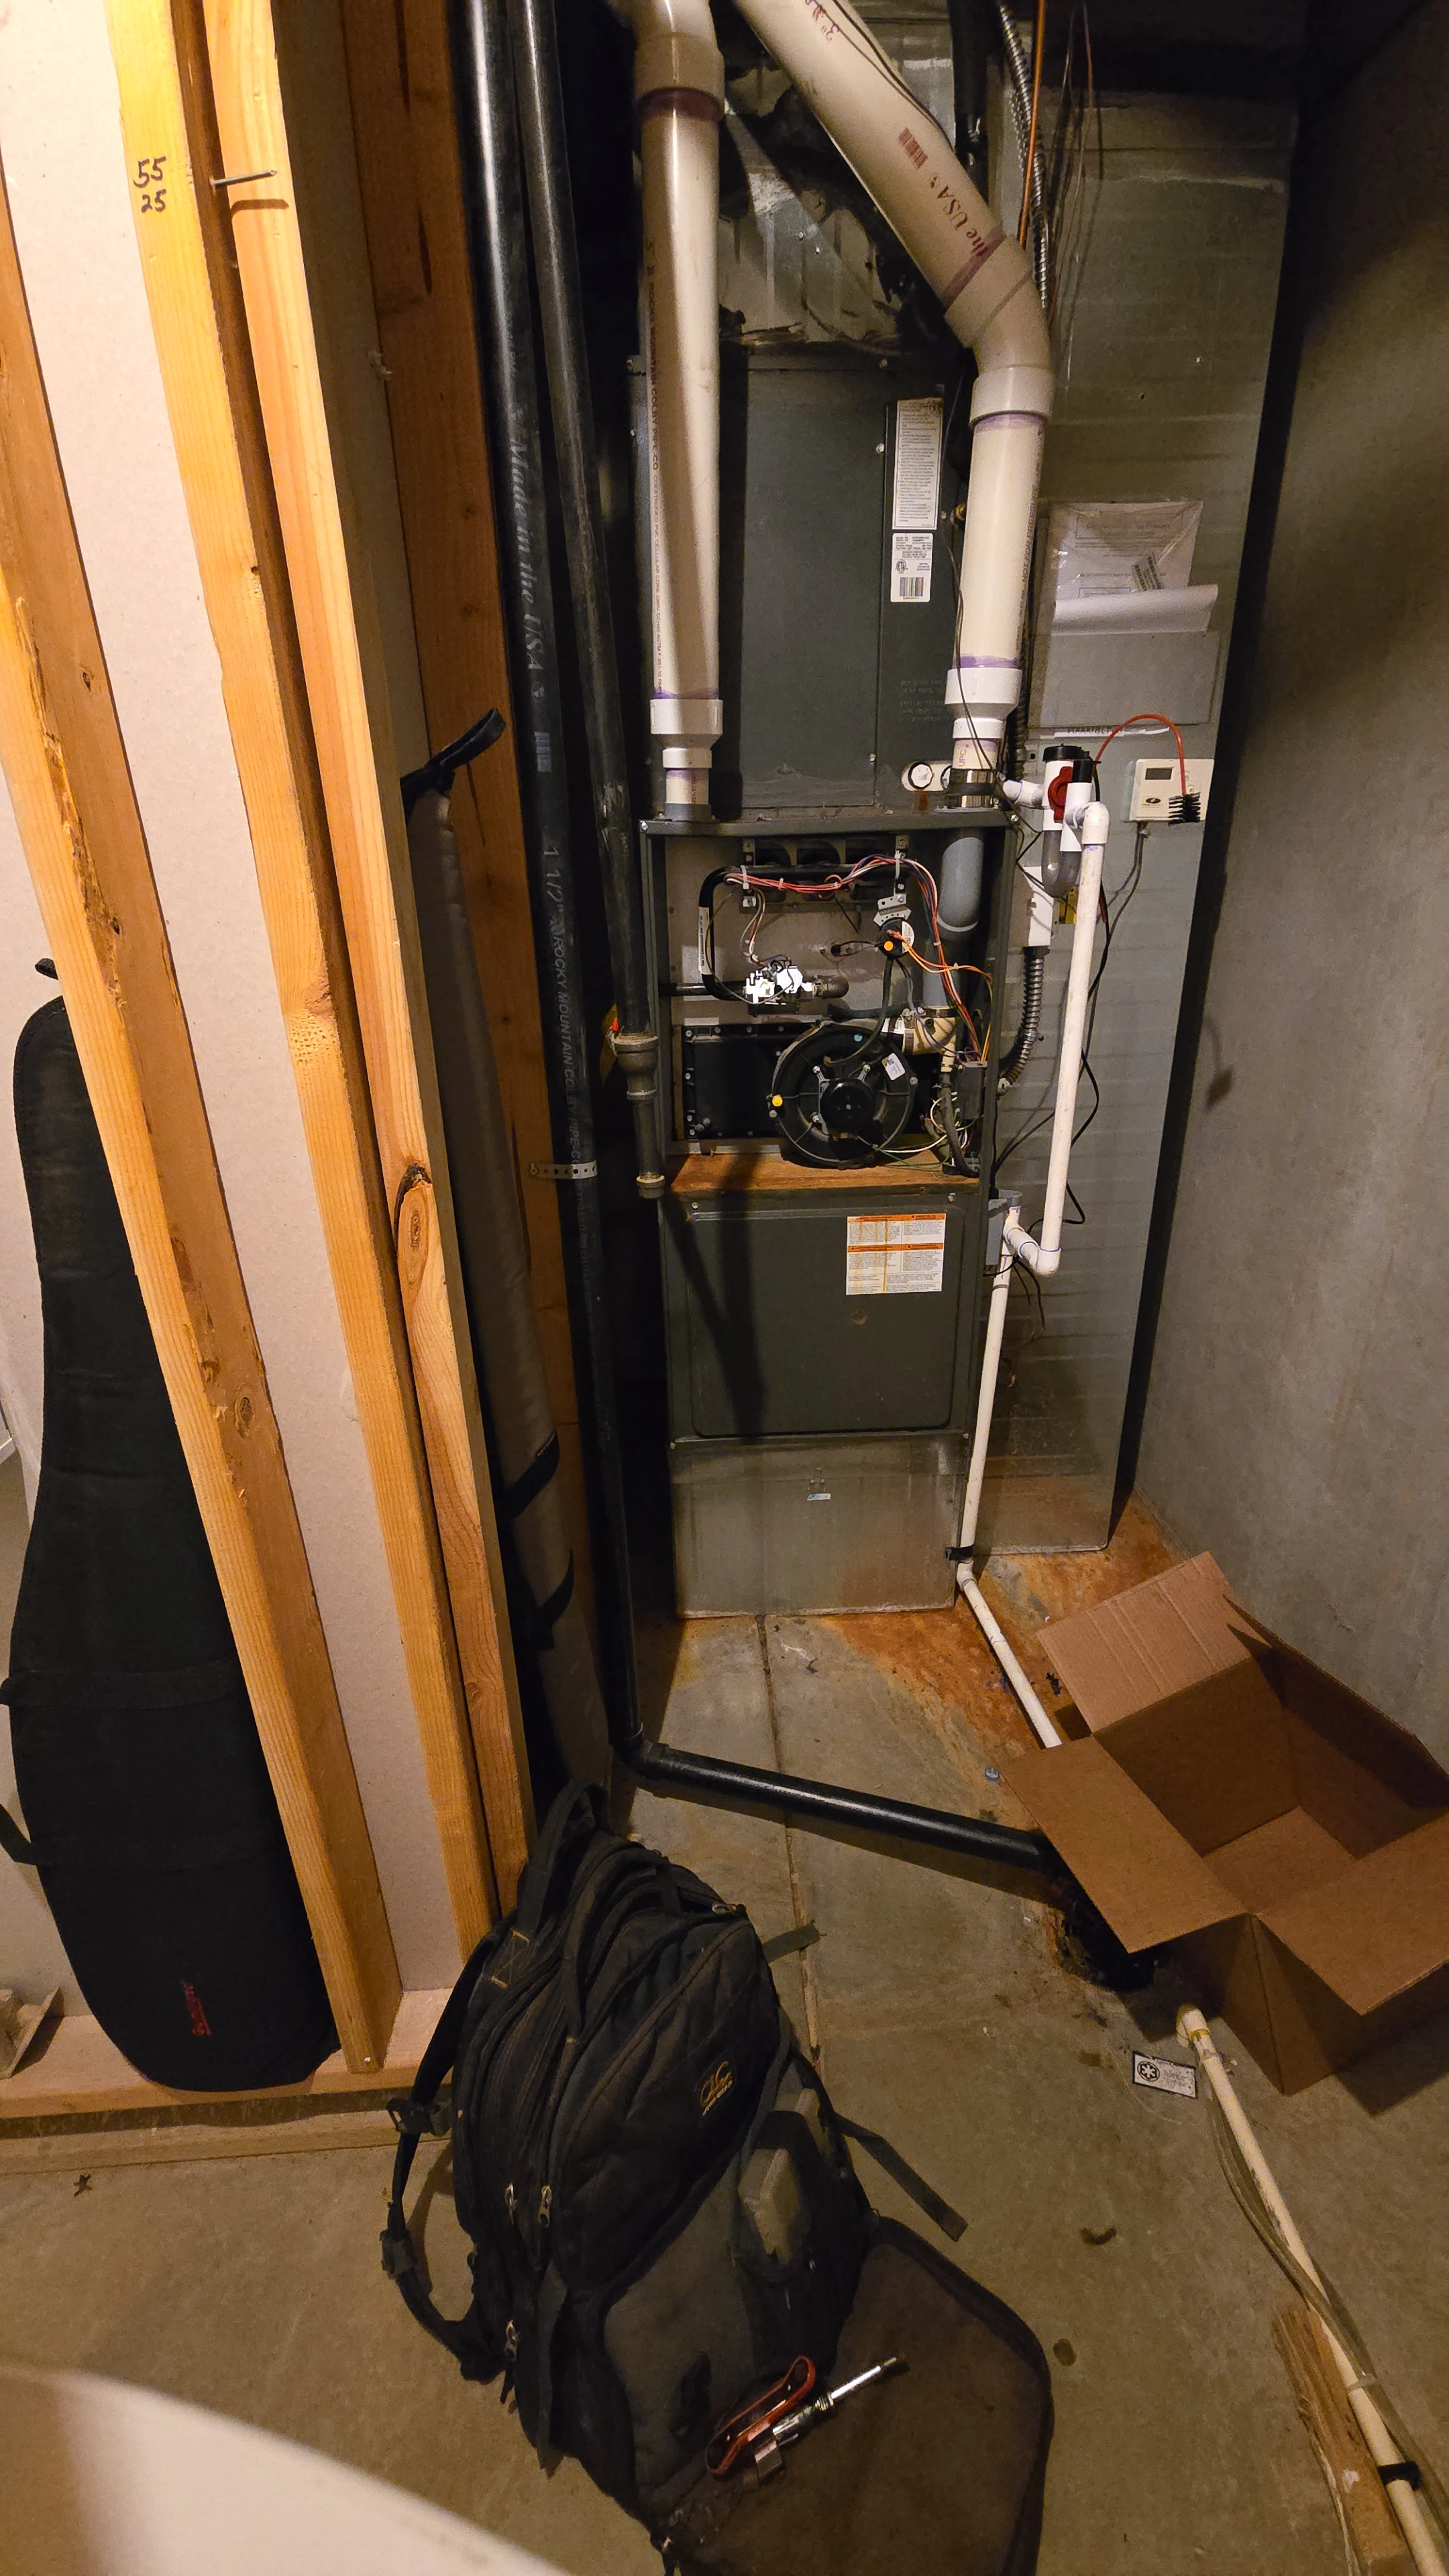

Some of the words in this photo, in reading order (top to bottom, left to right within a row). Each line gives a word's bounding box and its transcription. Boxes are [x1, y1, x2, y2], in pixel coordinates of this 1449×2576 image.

[133, 156, 166, 188] 55
[141, 189, 166, 213] 25
[937, 185, 969, 231] USA
[649, 326, 658, 384] MOUNTAIN
[509, 437, 531, 519] Made
[516, 523, 535, 554] in
[519, 560, 539, 604] the
[523, 612, 544, 671] USA
[958, 749, 967, 767] UPC
[543, 846, 559, 857] 1
[553, 935, 568, 989] ROCKY
[557, 990, 574, 1066] MOUNTAIN
[564, 1067, 578, 1112] COLBY
